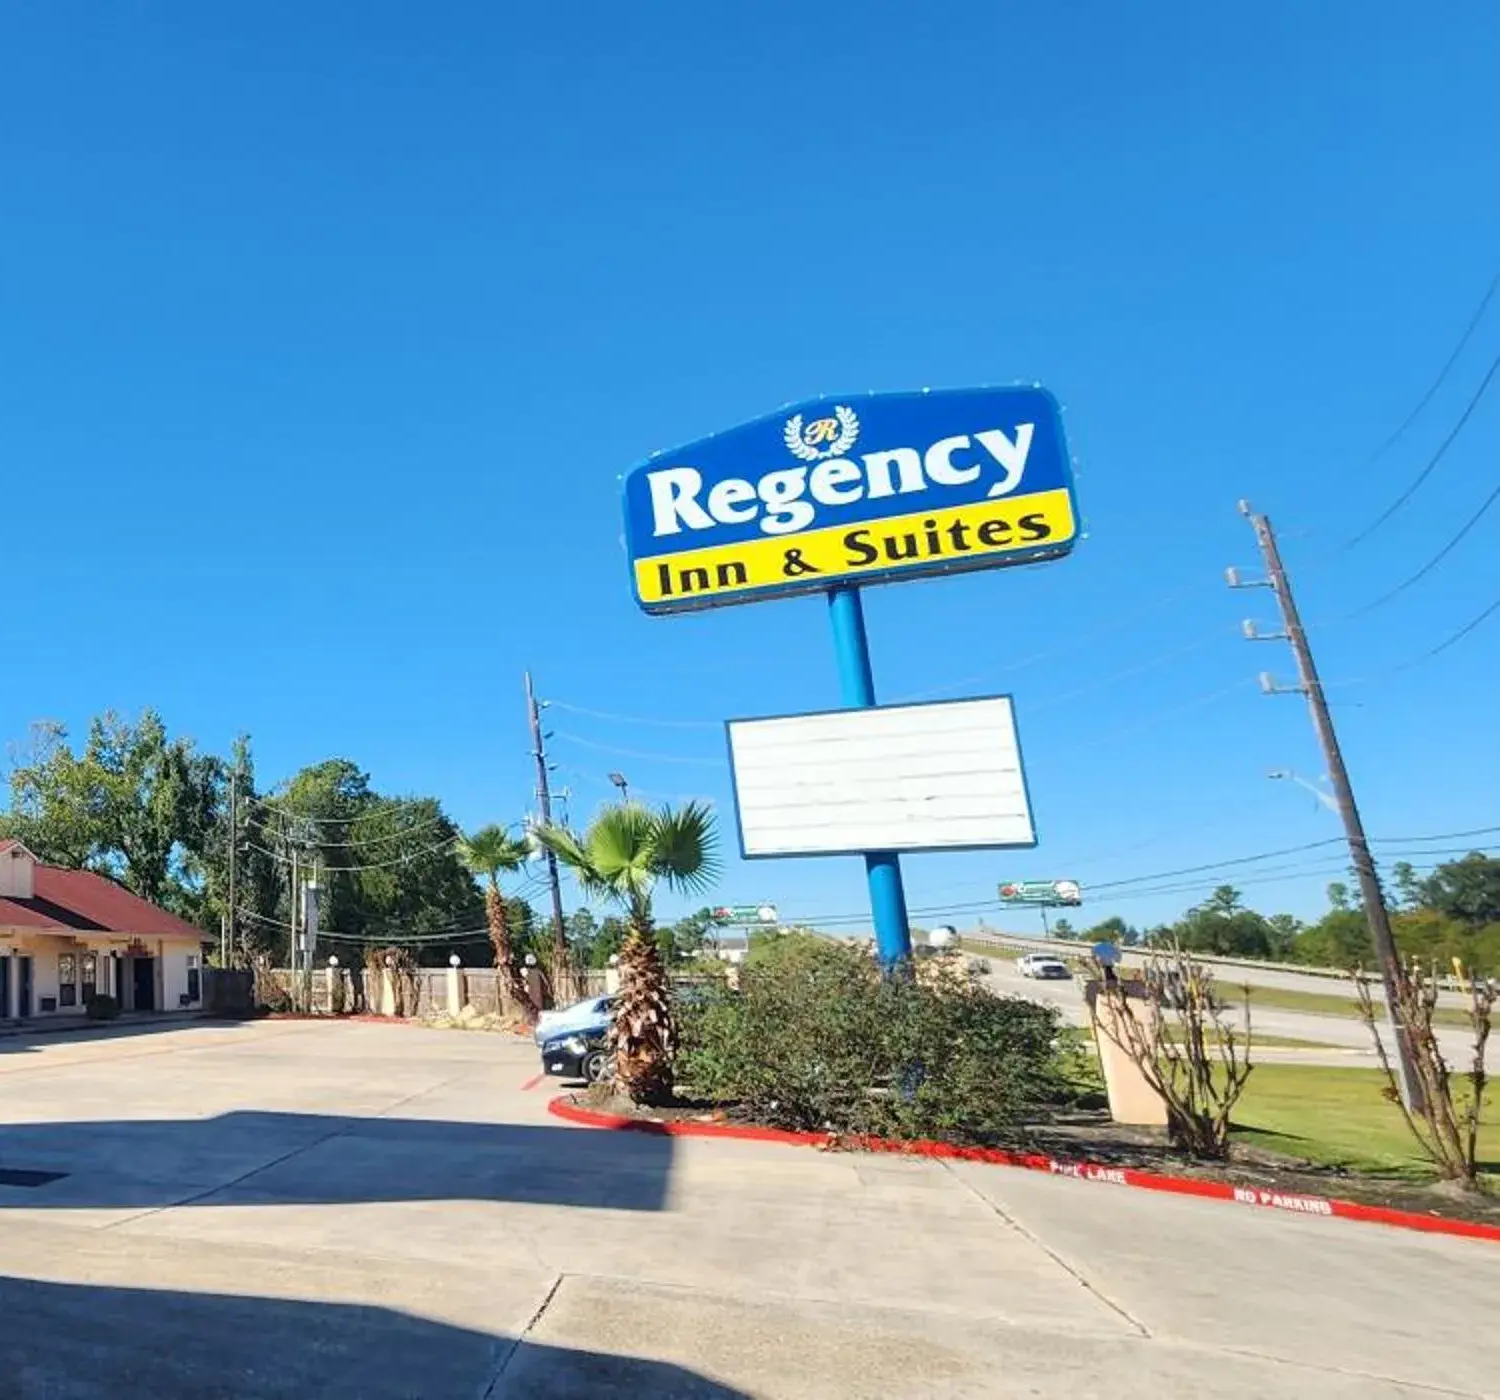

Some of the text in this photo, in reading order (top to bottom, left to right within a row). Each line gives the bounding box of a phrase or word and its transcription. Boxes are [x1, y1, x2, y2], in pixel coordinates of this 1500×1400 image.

[804, 418, 838, 442] R
[647, 423, 1035, 535] Regency
[658, 512, 1051, 595] Inn & Suites
[1235, 1188, 1333, 1214] NO PARKING
